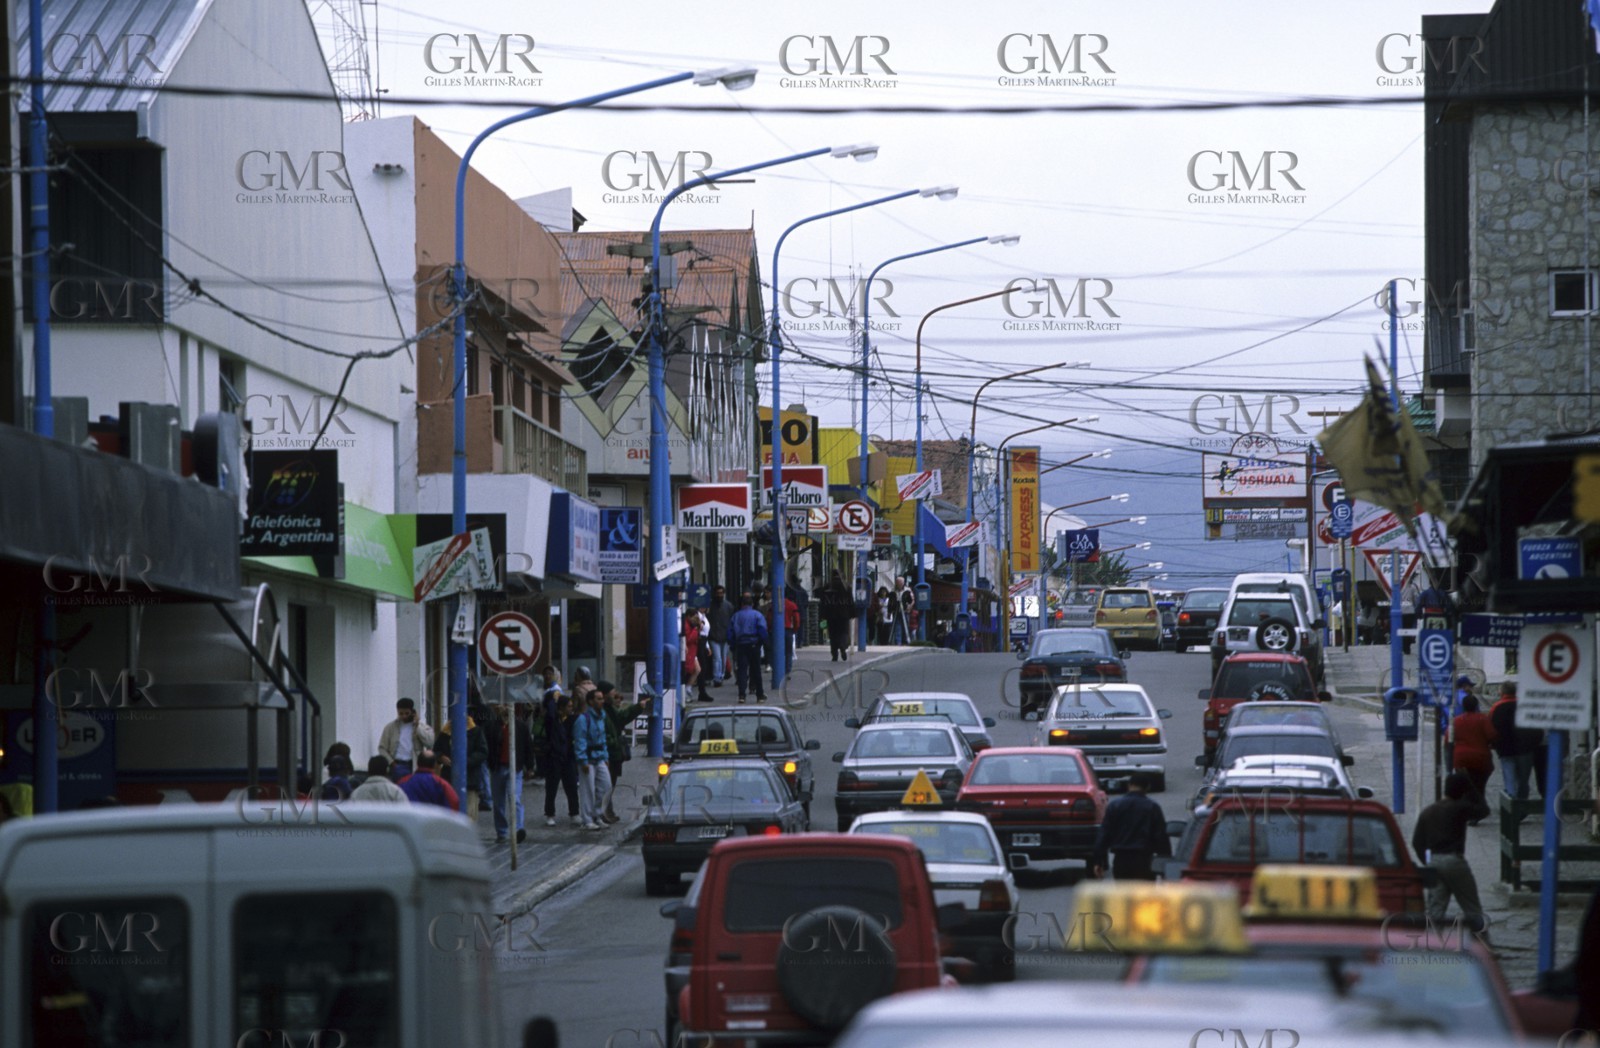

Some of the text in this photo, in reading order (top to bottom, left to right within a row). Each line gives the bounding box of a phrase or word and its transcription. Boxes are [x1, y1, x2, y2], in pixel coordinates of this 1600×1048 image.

[1239, 474, 1296, 486] USHUAIA
[682, 507, 746, 528] Marlboro
[849, 508, 863, 527] E
[1020, 487, 1031, 549] EXPRESS
[1337, 507, 1347, 518] E
[250, 515, 321, 529] Telefónica
[260, 530, 334, 548] Argentina
[1523, 543, 1551, 552] FUERZA
[1529, 552, 1572, 561] ARGENTINA
[1489, 618, 1525, 626] Lineas
[498, 626, 521, 661] E
[1469, 636, 1485, 644] del
[1429, 641, 1445, 662] E
[1548, 644, 1565, 673] E
[899, 704, 919, 713] 145
[707, 743, 730, 752] 164
